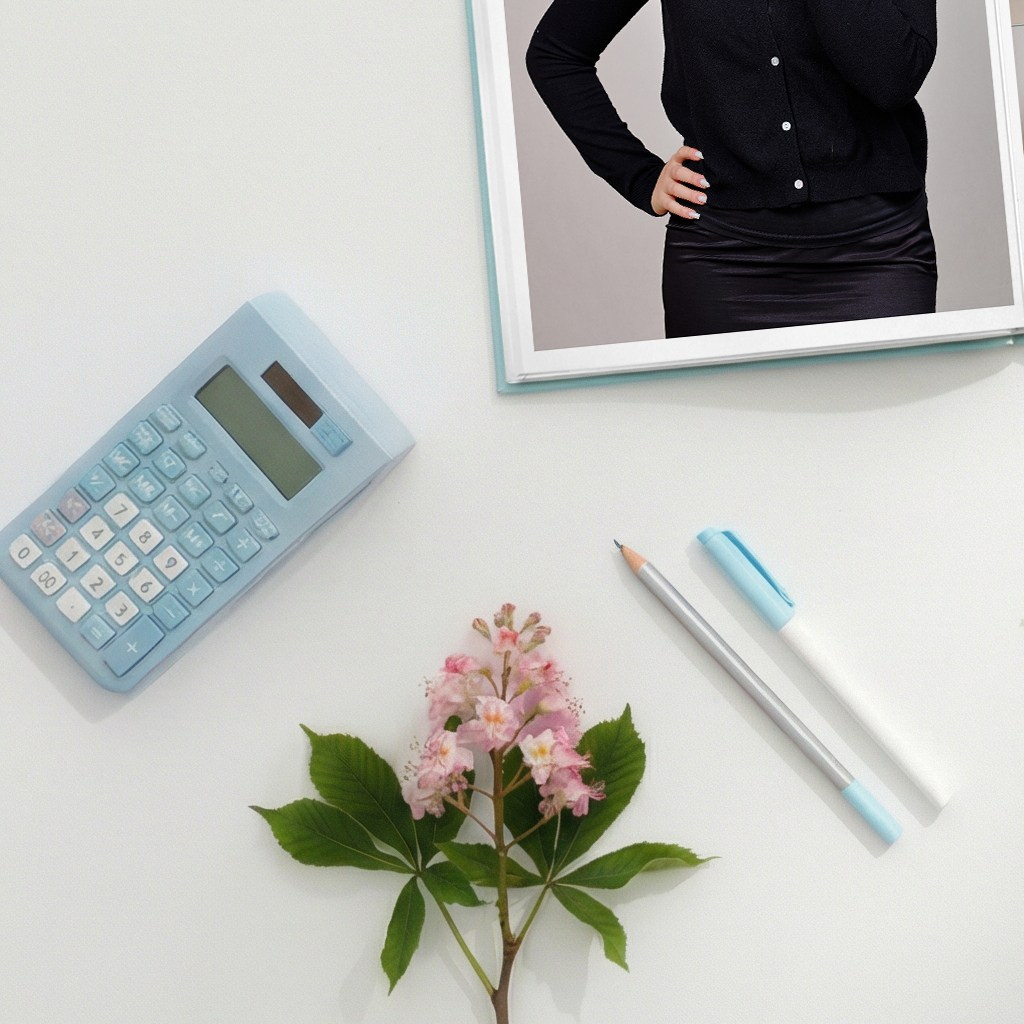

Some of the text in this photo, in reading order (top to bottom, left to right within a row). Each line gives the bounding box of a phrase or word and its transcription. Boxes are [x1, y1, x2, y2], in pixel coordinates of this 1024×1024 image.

[114, 504, 128, 516] 7
[91, 528, 104, 540] 4
[138, 531, 152, 544] 8
[18, 547, 30, 559] 0
[66, 550, 79, 563] 1
[114, 553, 127, 566] 5
[165, 557, 178, 568] 9
[38, 571, 57, 589] 00
[89, 577, 103, 592] 2
[140, 581, 153, 594] 6
[115, 603, 128, 617] 3
